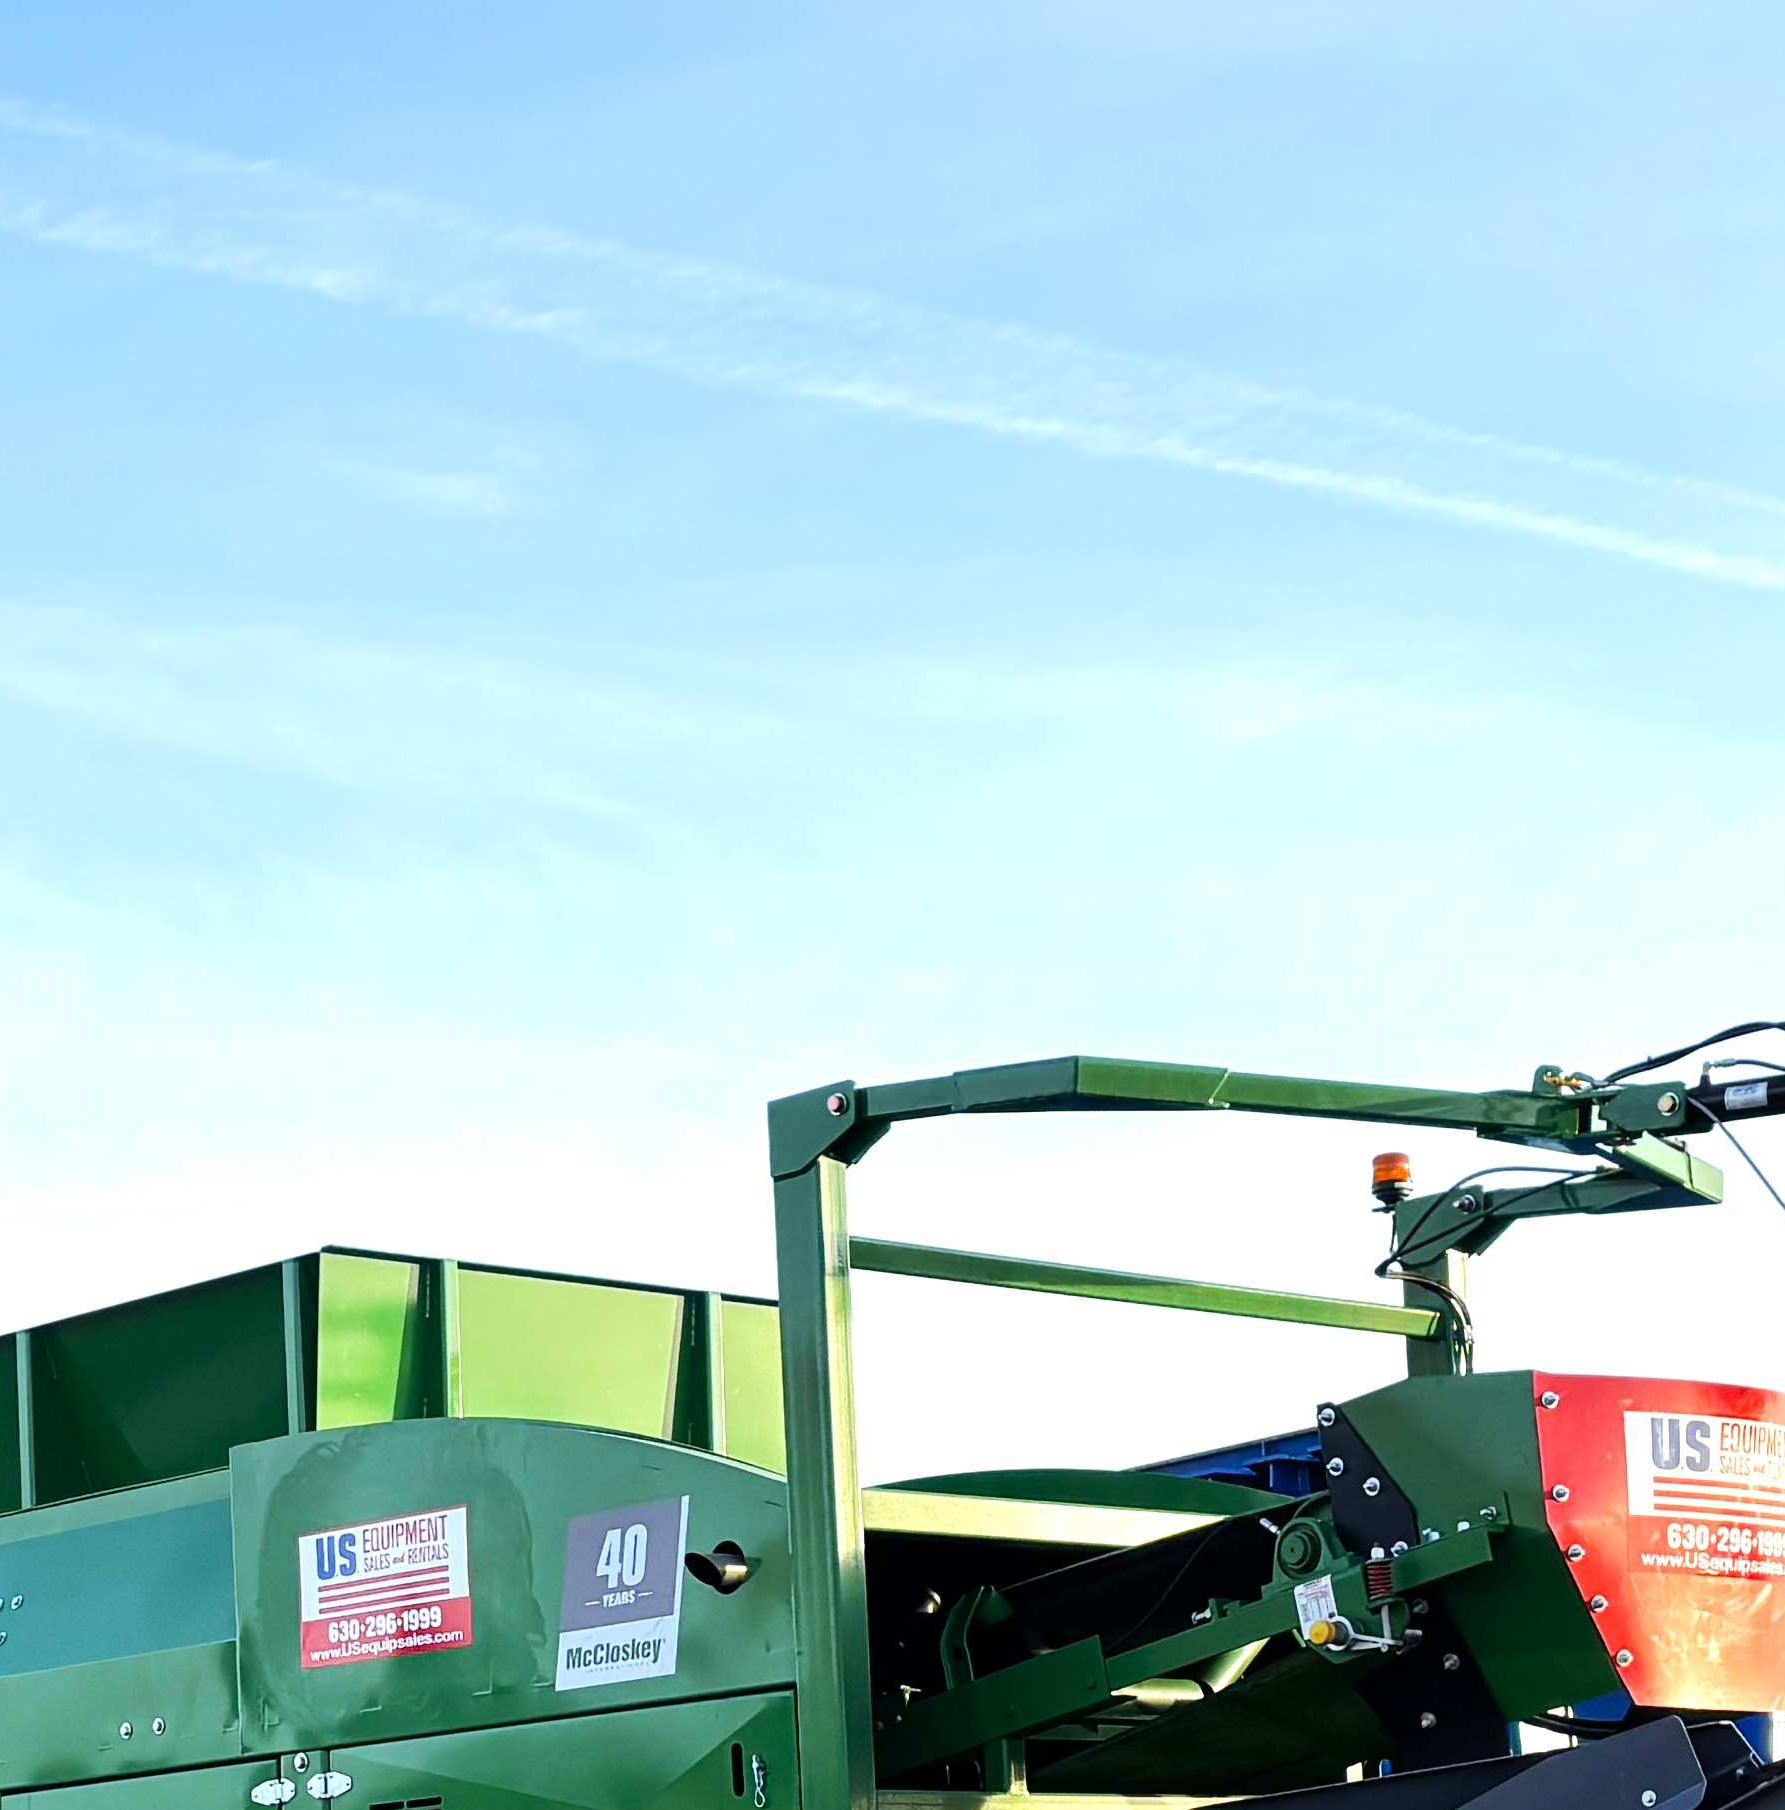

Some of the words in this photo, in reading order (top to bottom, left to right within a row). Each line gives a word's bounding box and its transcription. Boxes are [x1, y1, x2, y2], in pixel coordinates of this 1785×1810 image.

[1719, 1455, 1751, 1476] SALES
[362, 1514, 447, 1553] EQUIPMENT
[364, 1553, 391, 1573] SALES
[407, 1543, 449, 1565] RENTALS
[596, 1523, 648, 1589] 40
[602, 1589, 636, 1608] YEARS
[310, 1630, 464, 1661] www.USequipsales.com
[566, 1637, 661, 1670] McCloskey
